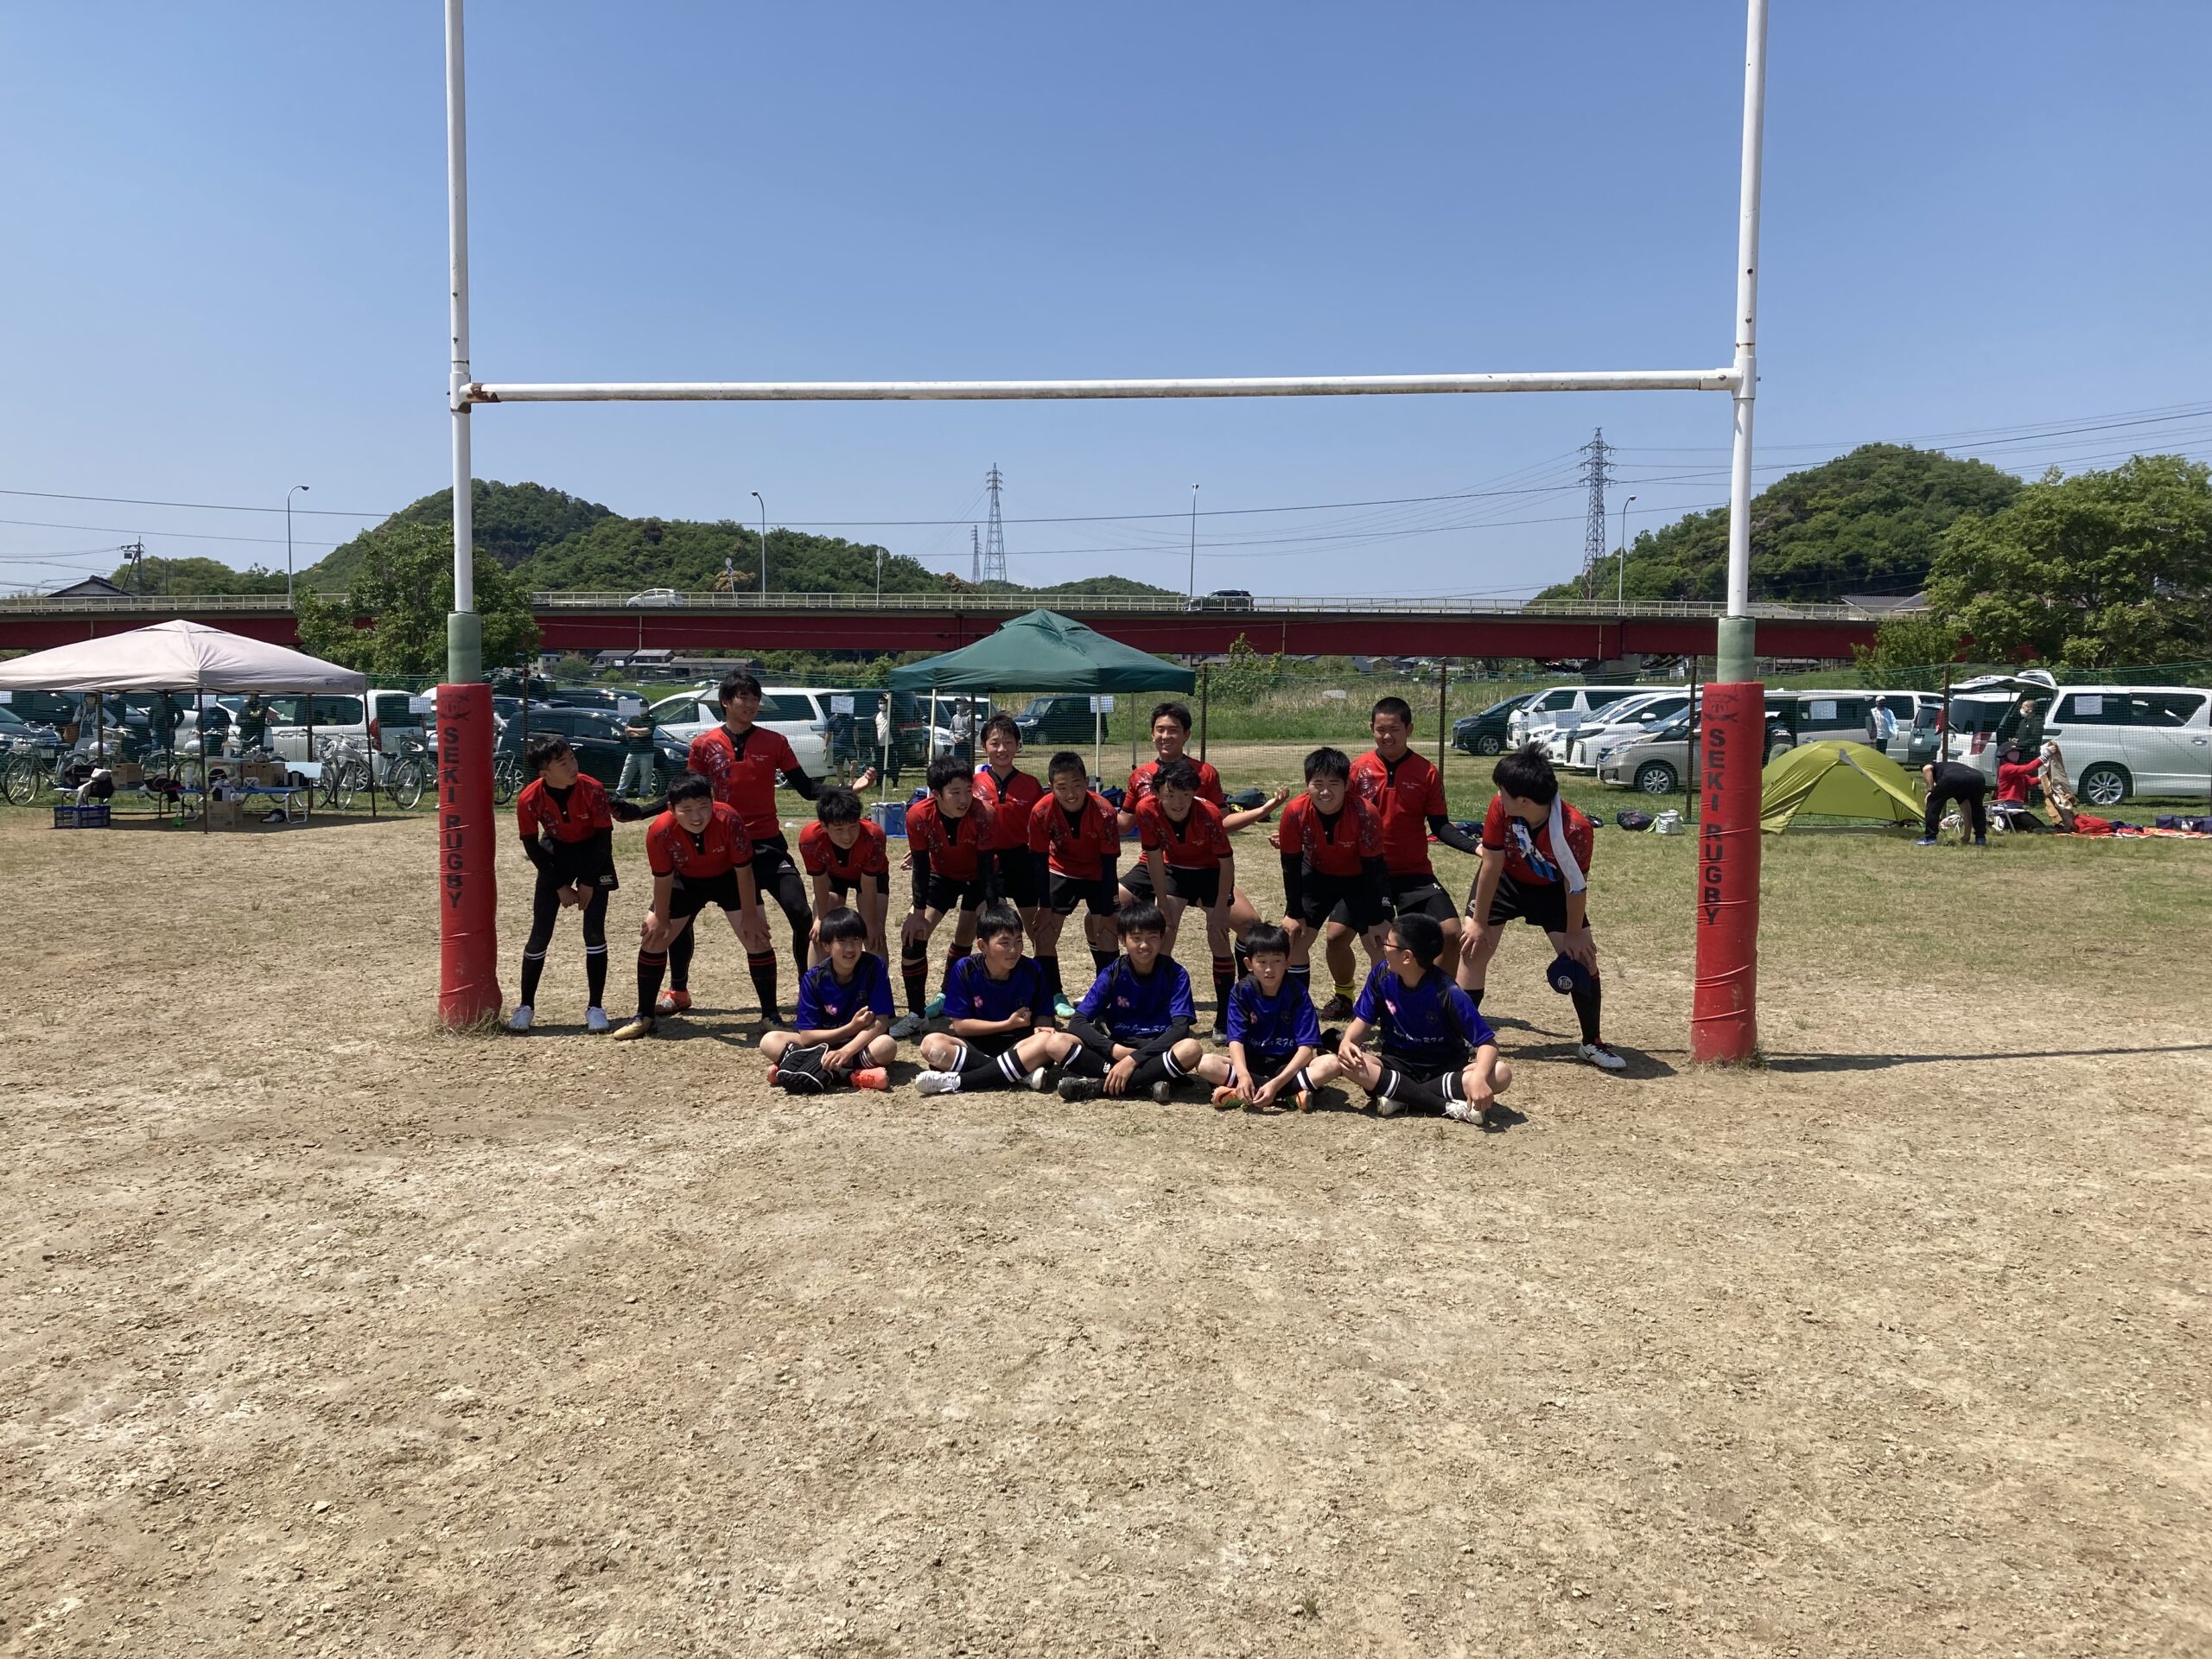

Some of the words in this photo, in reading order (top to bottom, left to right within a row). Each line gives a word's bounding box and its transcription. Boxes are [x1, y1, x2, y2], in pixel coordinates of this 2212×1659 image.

[443, 727, 460, 804] SEKI
[1707, 728, 1726, 812] SEKI
[445, 814, 463, 909] RUGBY
[1704, 823, 1724, 926] RUGBY
